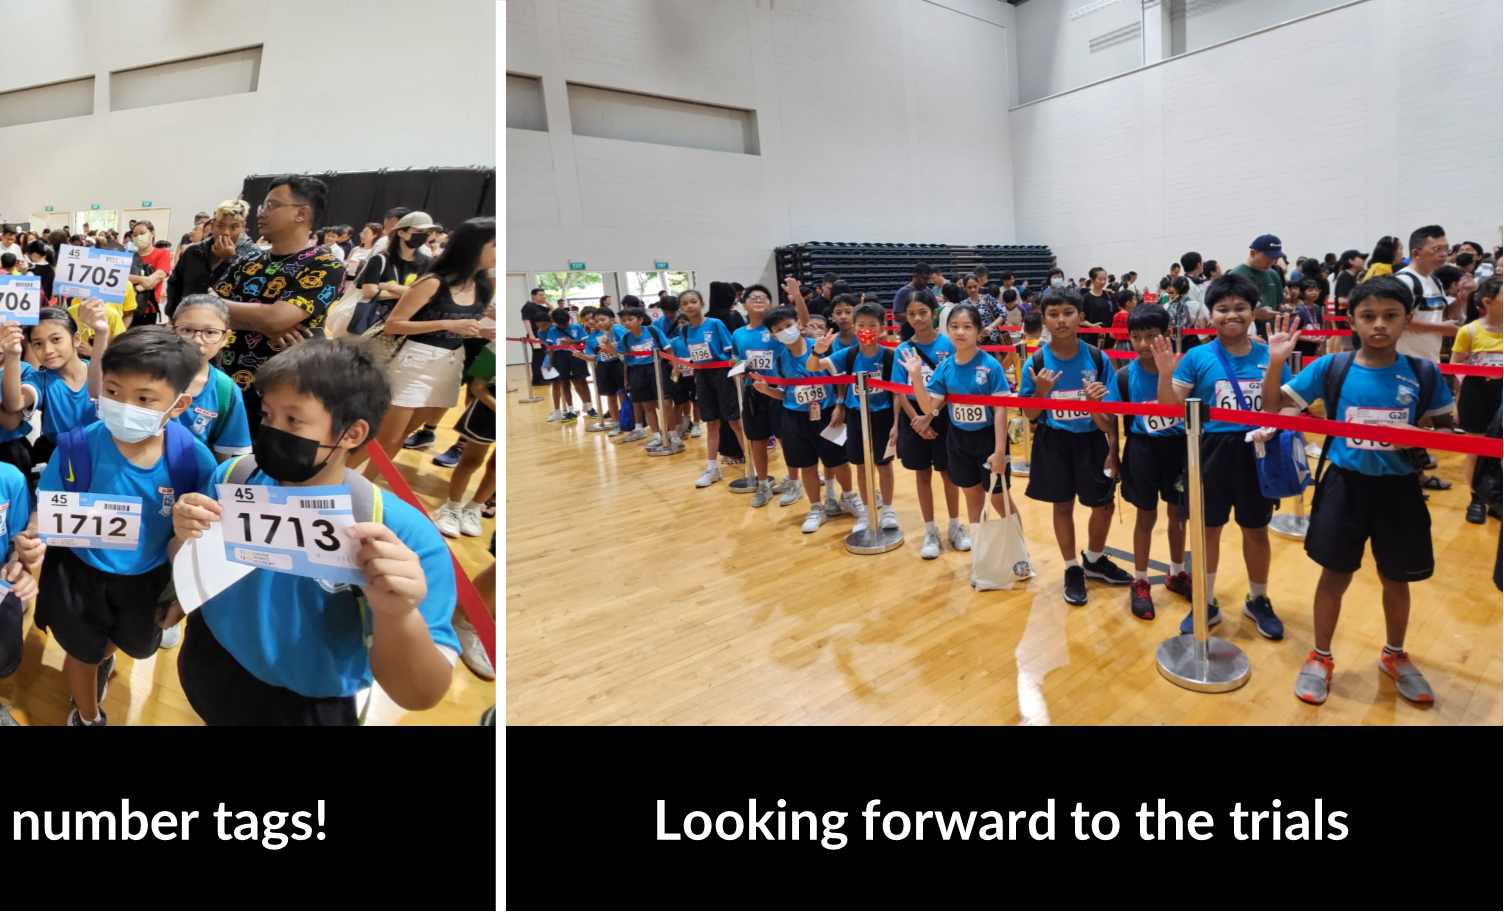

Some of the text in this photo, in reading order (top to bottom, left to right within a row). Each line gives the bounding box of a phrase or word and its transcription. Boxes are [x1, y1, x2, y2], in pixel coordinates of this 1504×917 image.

[68, 249, 81, 257] 45
[67, 262, 121, 287] 1705
[691, 350, 709, 360] 6196
[797, 387, 824, 403] 6198
[956, 407, 983, 421] 6189
[1388, 412, 1408, 420] G20
[51, 494, 68, 504] 45
[234, 487, 255, 500] 45
[52, 513, 127, 537] 1712
[237, 512, 341, 552] 1713
